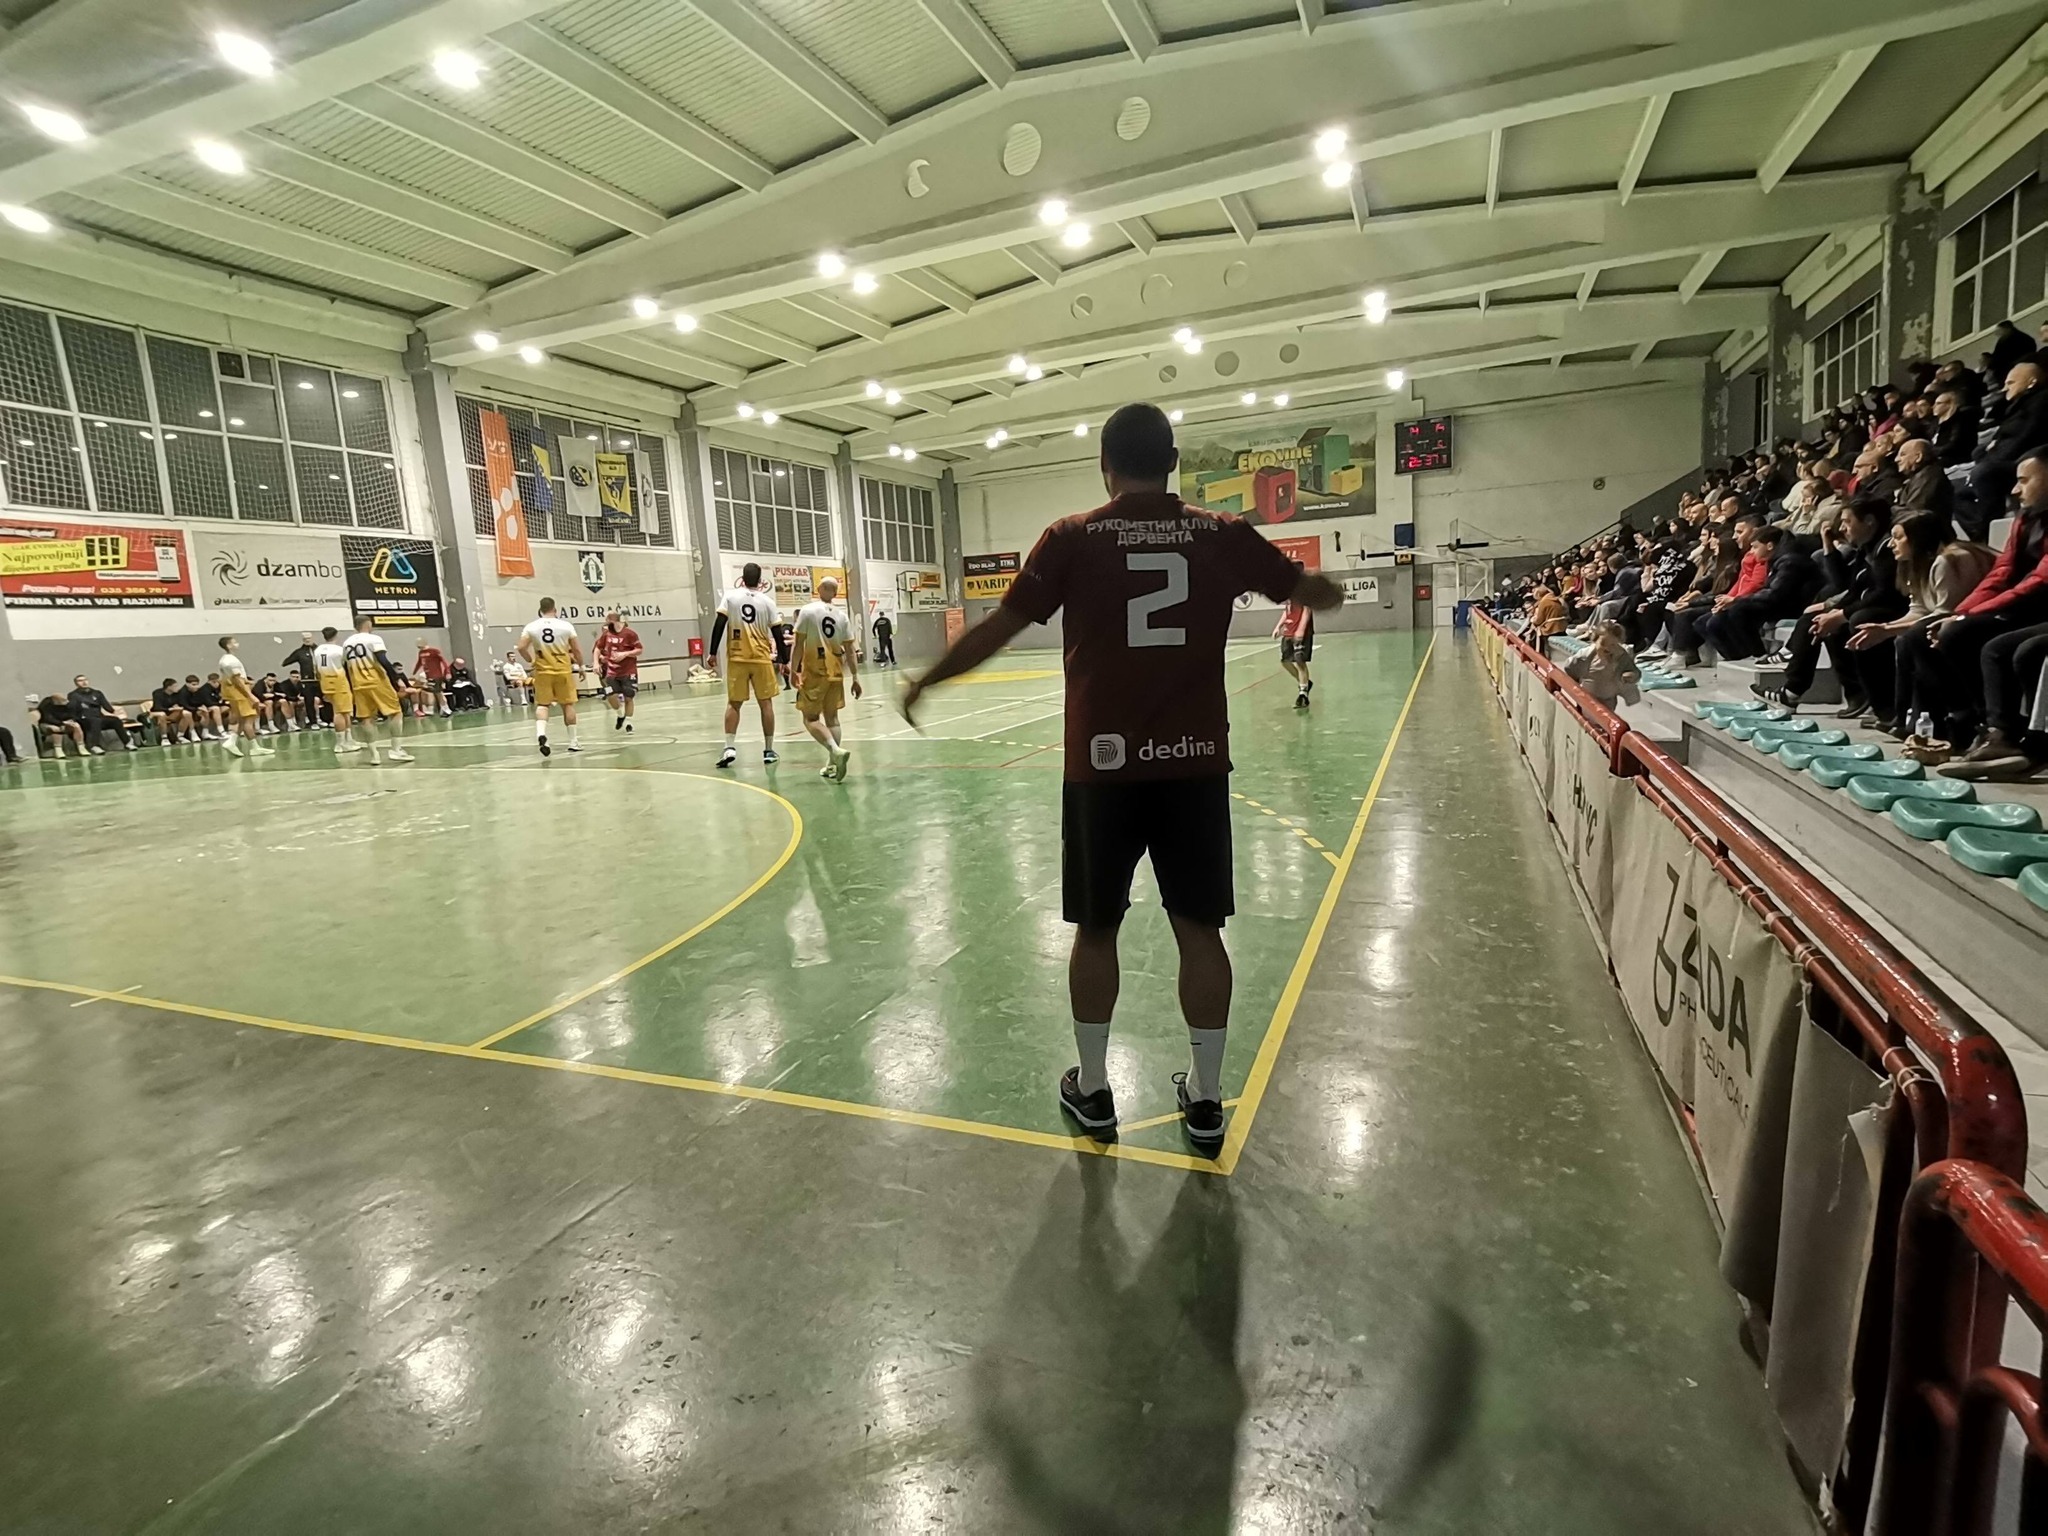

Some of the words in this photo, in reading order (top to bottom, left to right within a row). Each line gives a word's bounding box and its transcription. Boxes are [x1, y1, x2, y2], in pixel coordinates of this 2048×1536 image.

[1086, 519, 1176, 535] РУКОМЕТНИ
[1181, 517, 1219, 531] КЛУБ
[1117, 530, 1194, 546] ДЕРВЕНТА
[257, 557, 342, 579] dzambo
[374, 586, 417, 595] METRON
[1352, 580, 1377, 591] LIGA
[4, 596, 52, 606] FIRMA
[56, 596, 92, 606] KOJA
[95, 596, 120, 606] VAS
[1127, 552, 1189, 647] 2
[741, 604, 756, 624] 9
[821, 616, 836, 638] 6
[541, 628, 555, 644] 8
[345, 643, 367, 660] 20
[1138, 736, 1215, 761] dedina
